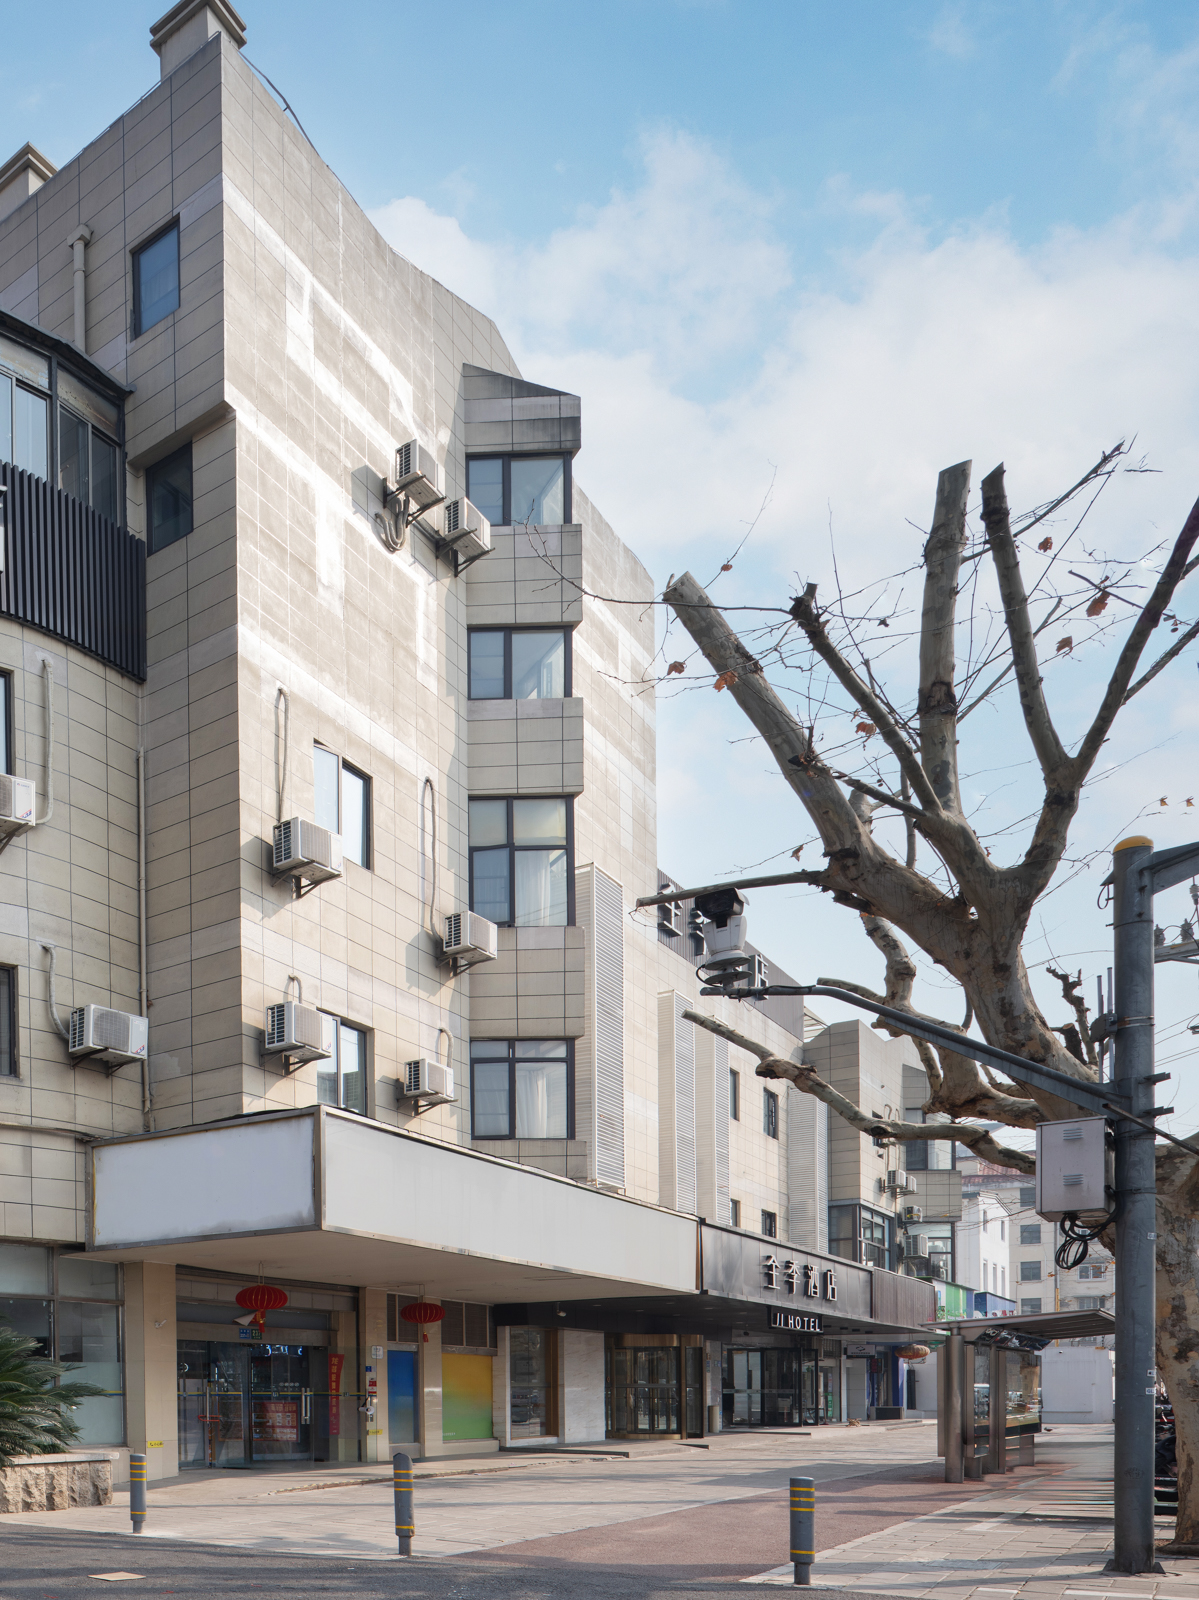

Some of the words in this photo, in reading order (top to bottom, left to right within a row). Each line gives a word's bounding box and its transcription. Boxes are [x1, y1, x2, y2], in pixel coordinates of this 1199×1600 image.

[766, 1255, 837, 1301] 全季酒店
[788, 1315, 820, 1331] HOTEL
